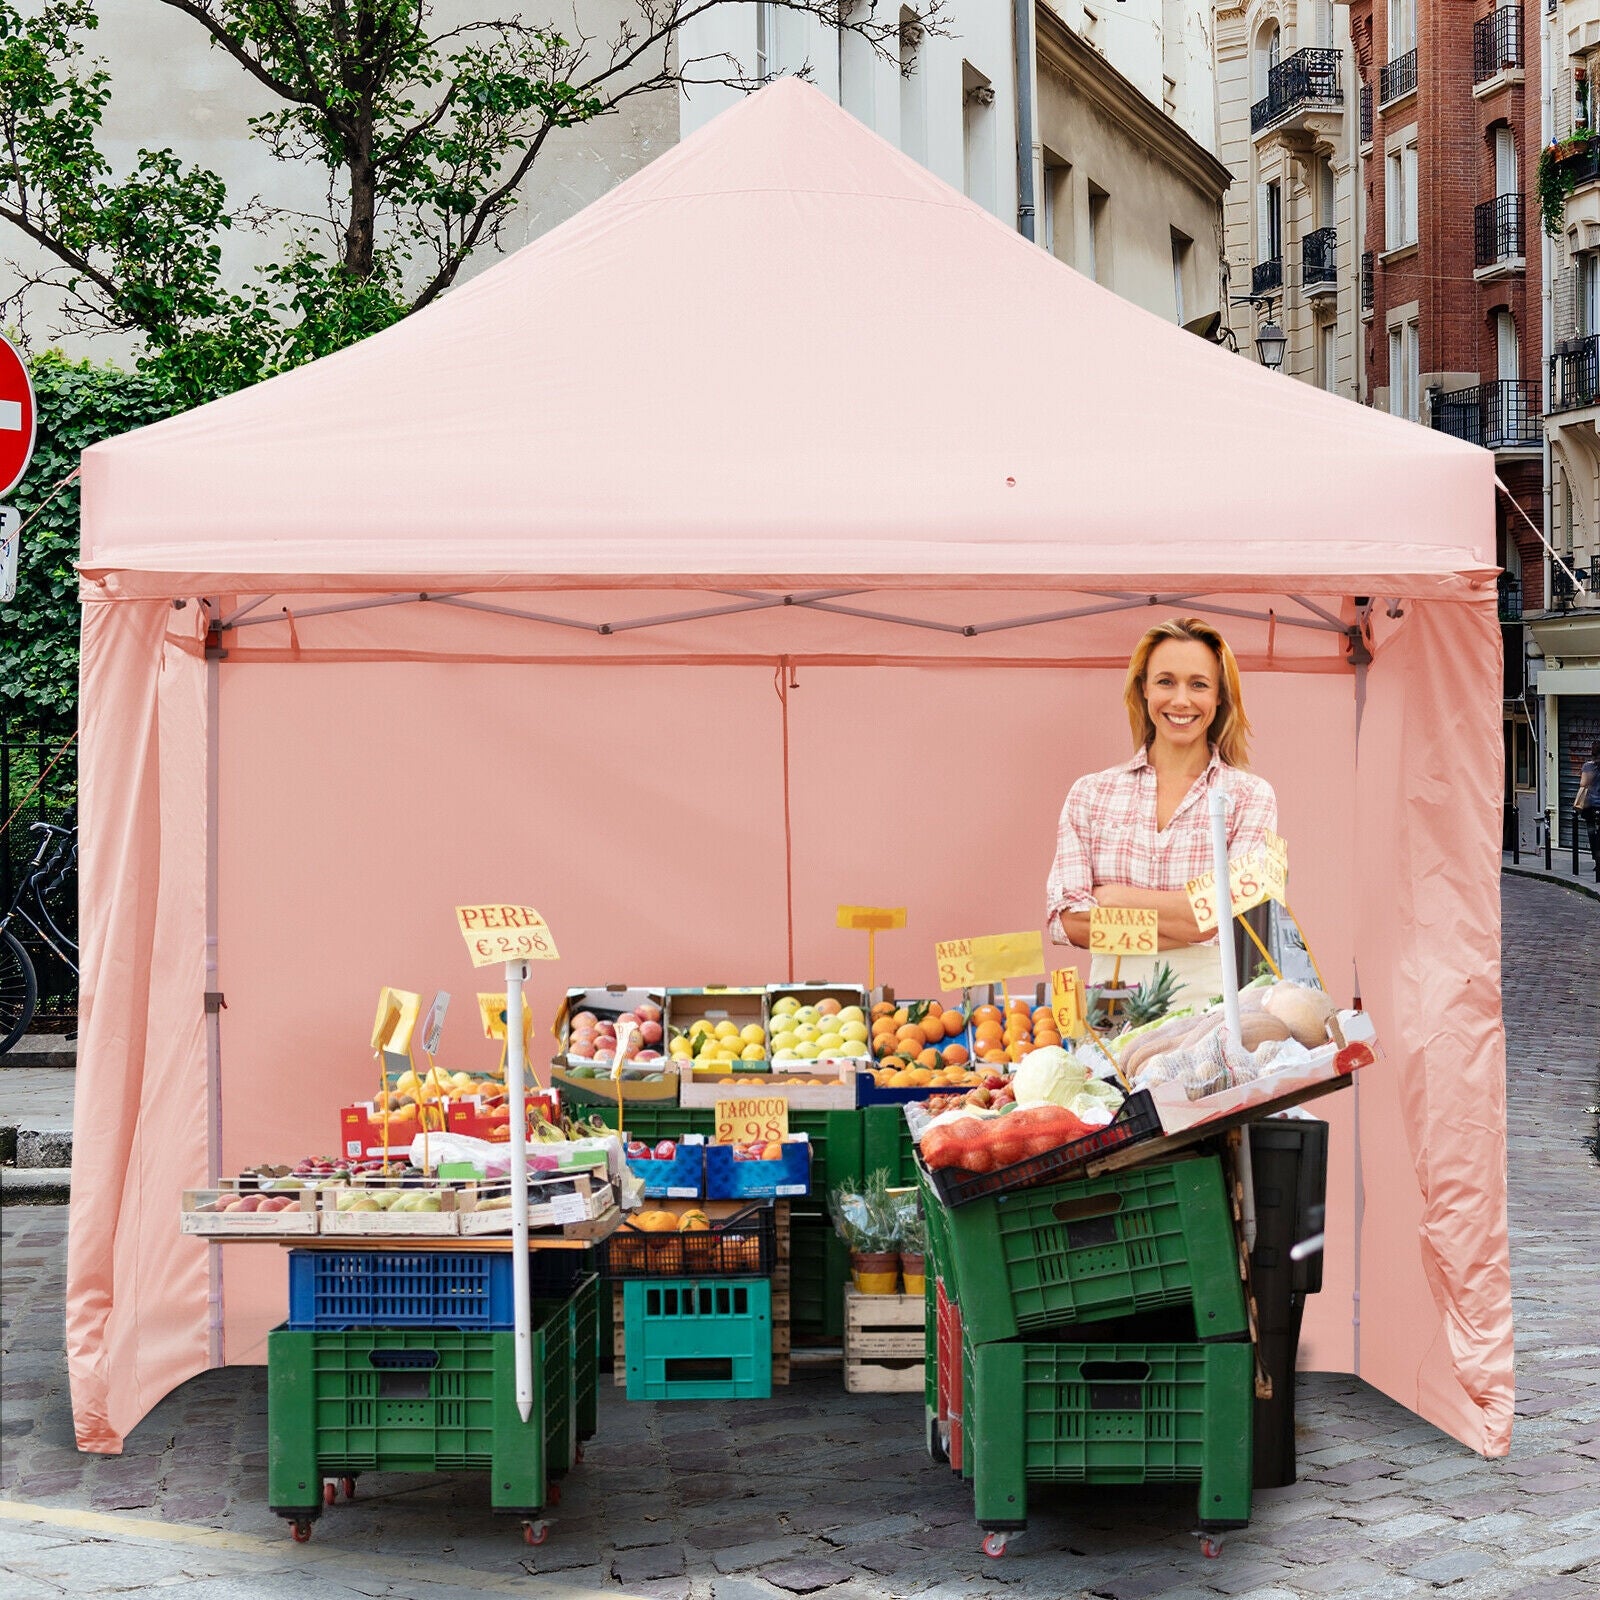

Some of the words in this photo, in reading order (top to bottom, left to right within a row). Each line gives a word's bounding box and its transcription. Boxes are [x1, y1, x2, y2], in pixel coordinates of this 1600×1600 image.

[461, 906, 542, 929] PERE
[1092, 908, 1155, 927] ANANAS
[476, 939, 493, 956] €
[496, 933, 549, 953] 2,98
[718, 1100, 784, 1118] TAROCCO
